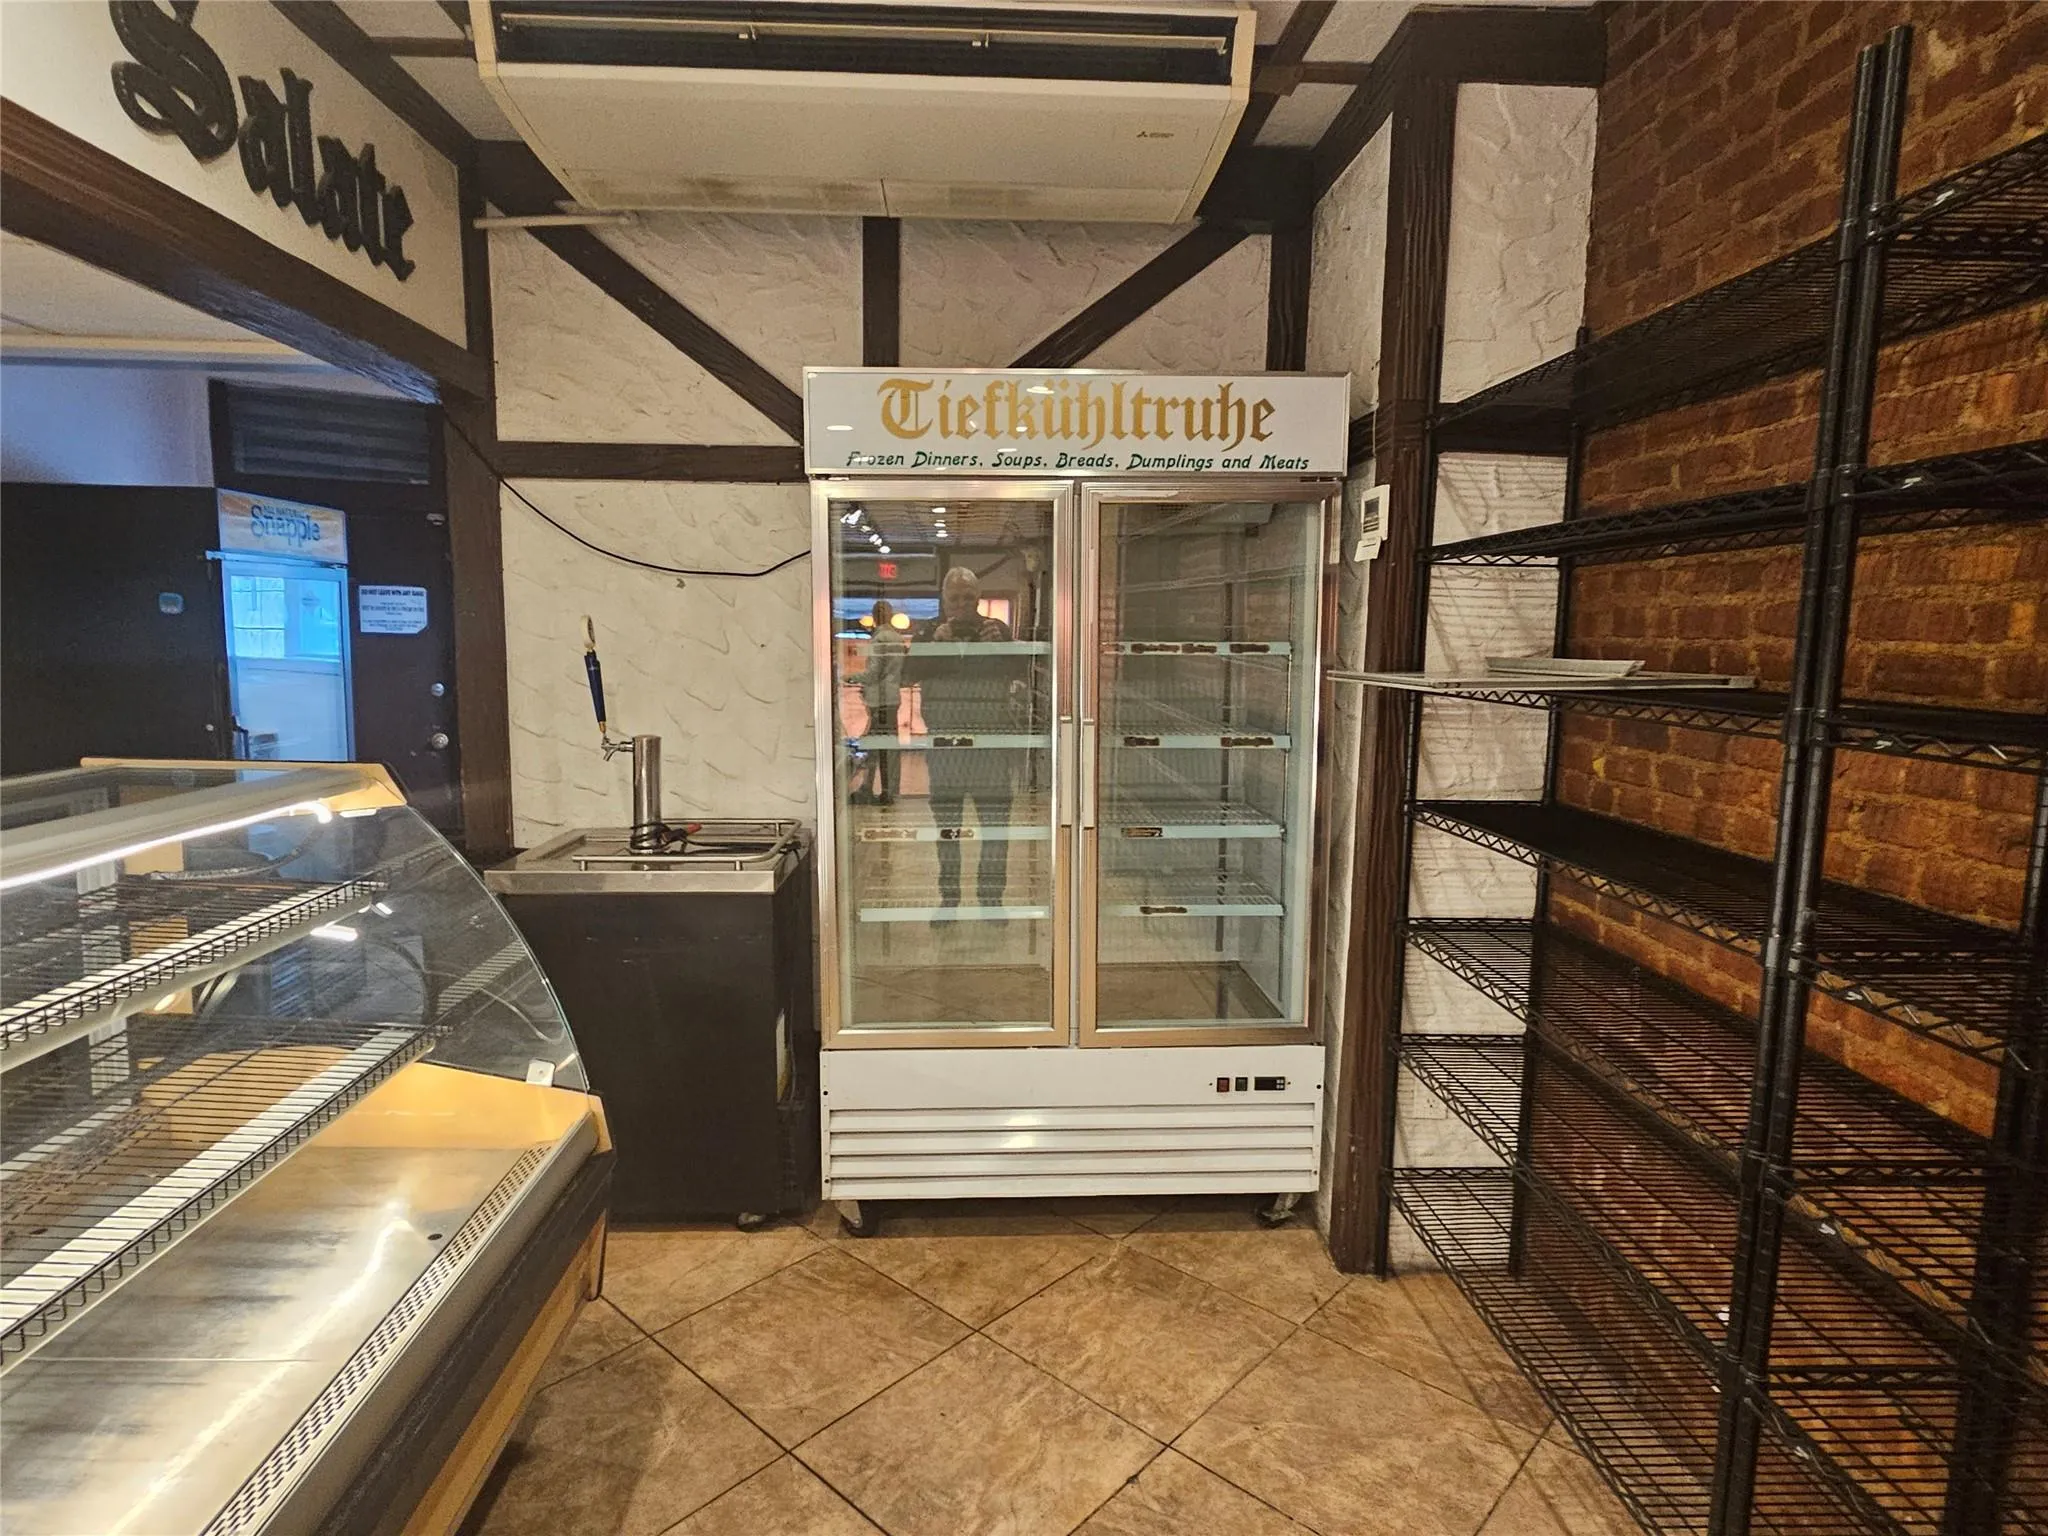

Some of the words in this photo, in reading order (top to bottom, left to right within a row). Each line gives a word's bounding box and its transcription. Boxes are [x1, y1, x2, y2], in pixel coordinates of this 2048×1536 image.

[877, 378, 1275, 453] Tiefkühltruhe
[846, 451, 904, 466] Frozen
[1126, 453, 1214, 471] Dumplings
[1221, 455, 1253, 469] and
[1259, 454, 1310, 470] Meats
[250, 504, 321, 548] Snapple
